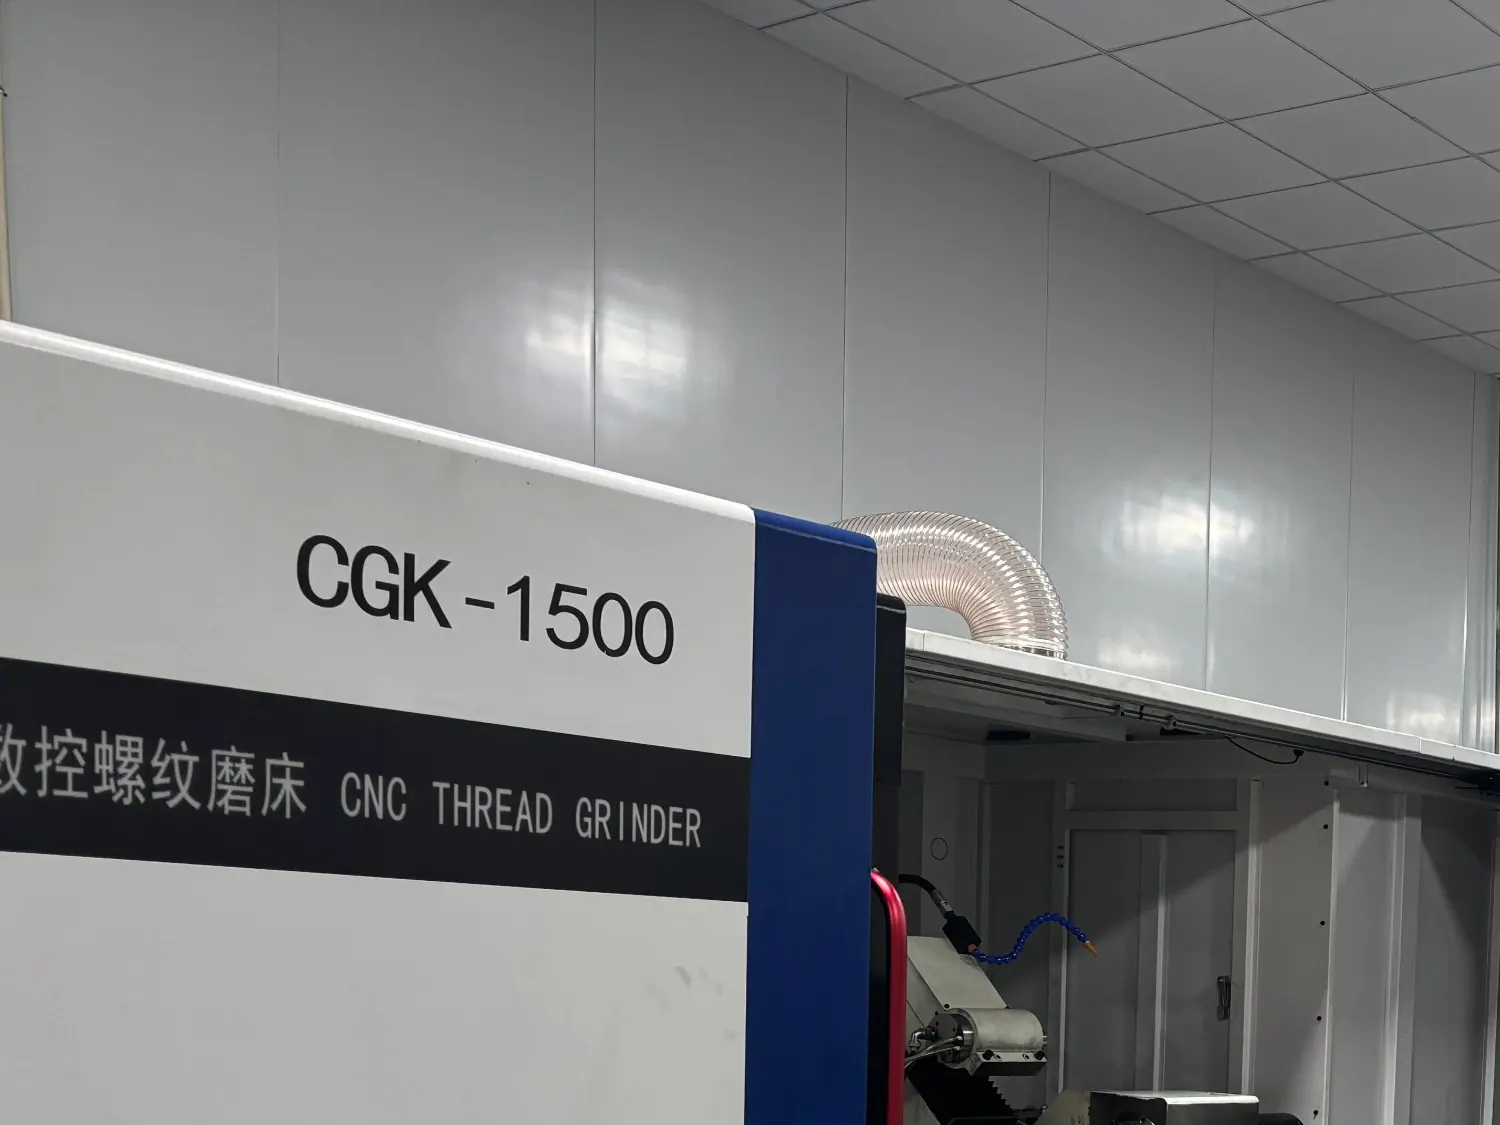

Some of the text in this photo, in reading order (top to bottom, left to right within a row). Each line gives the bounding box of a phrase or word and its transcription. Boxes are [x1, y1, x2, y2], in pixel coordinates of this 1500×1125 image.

[296, 534, 675, 665] CGK-1500
[340, 771, 701, 848] CNC THREAD GRINDER
